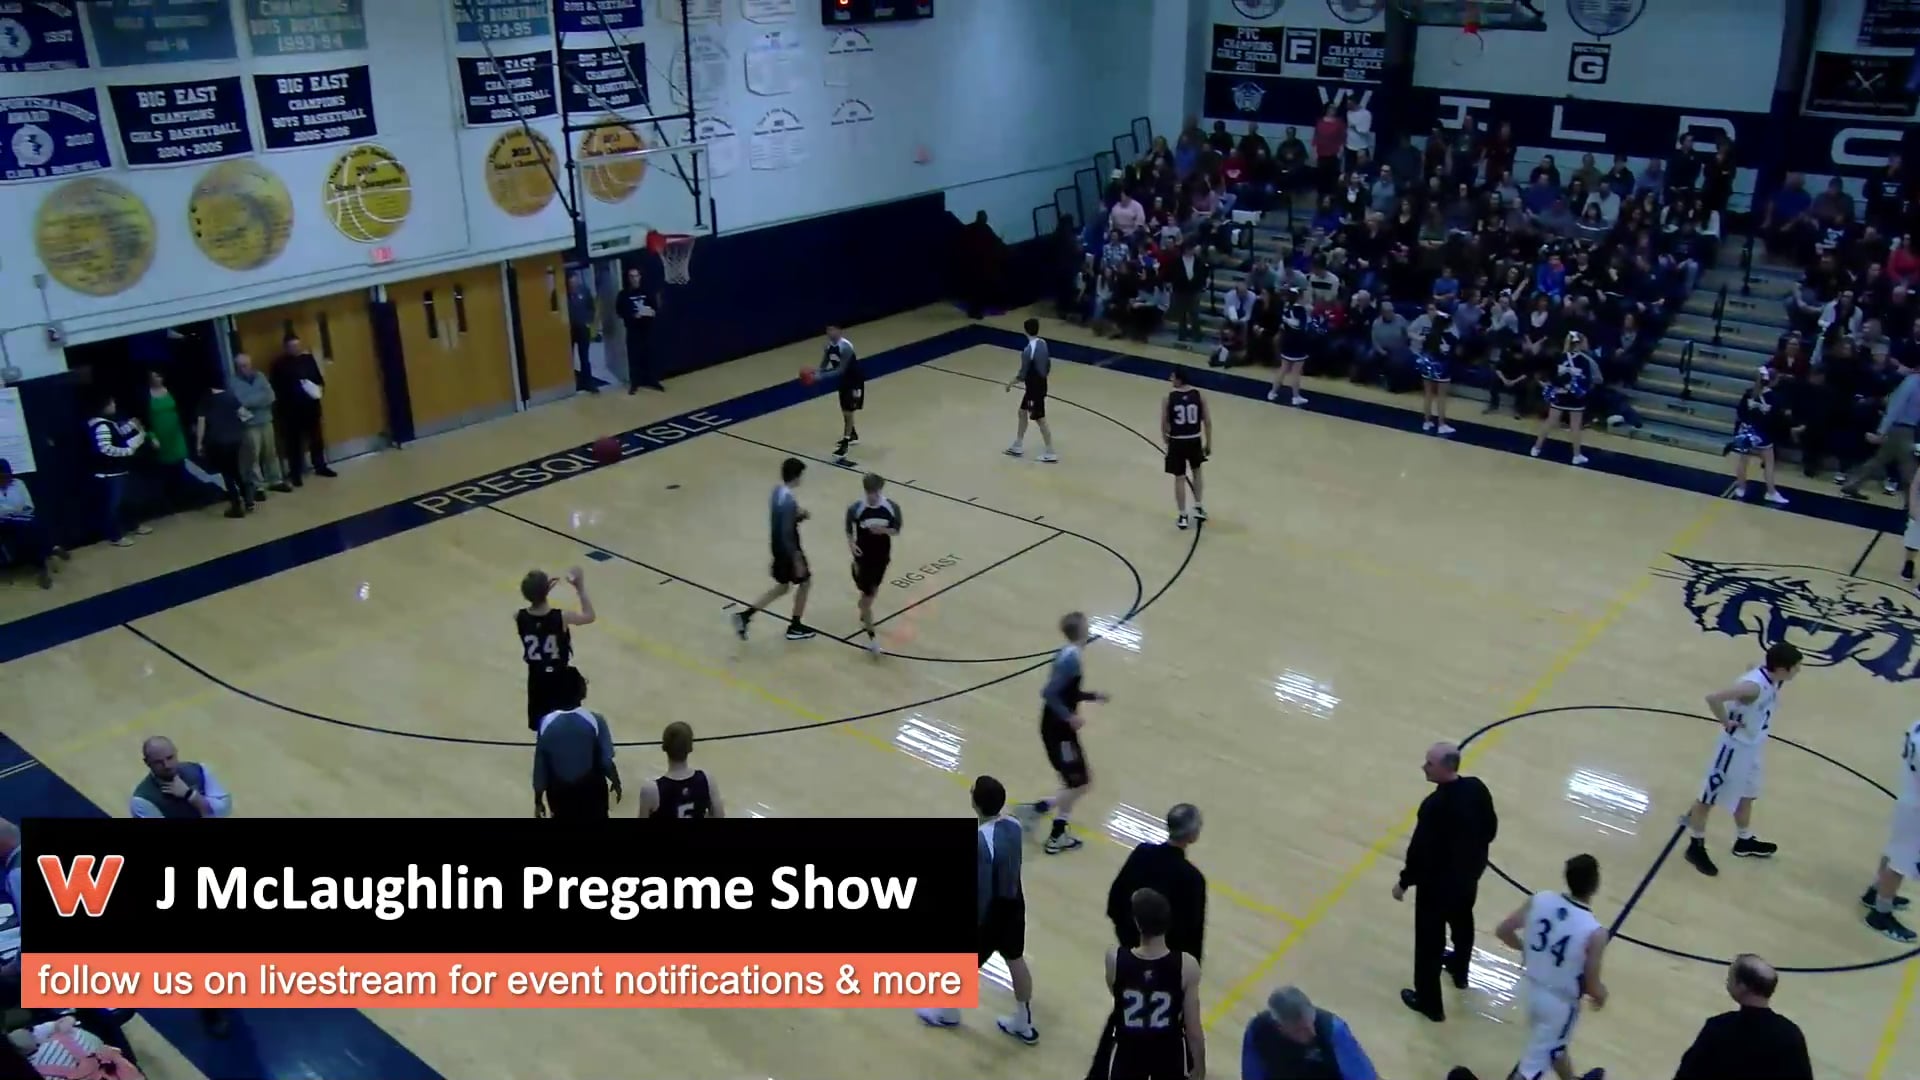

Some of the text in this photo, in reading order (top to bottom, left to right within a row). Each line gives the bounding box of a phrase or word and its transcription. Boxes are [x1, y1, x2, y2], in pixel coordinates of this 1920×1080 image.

[1223, 38, 1273, 51] CHAMPIONS
[1237, 28, 1260, 40] PVC
[1343, 31, 1371, 45] PVC
[1289, 38, 1313, 61] F
[503, 57, 537, 74] EAST
[1573, 55, 1604, 80] G
[277, 73, 349, 94] BIG EAST
[137, 86, 218, 108] BIG EAST
[288, 95, 346, 111] CHAMPIONS
[151, 108, 216, 125] CHAMPIONS
[272, 107, 368, 129] BOYS BASKETBALL
[130, 121, 242, 143] GIRLS BASKETBALL
[1173, 403, 1199, 425] 30
[634, 410, 733, 444] ISLE
[890, 552, 965, 589] BIG EAST
[524, 634, 561, 661] 24
[1531, 918, 1572, 967] 34
[1122, 989, 1172, 1028] 22
